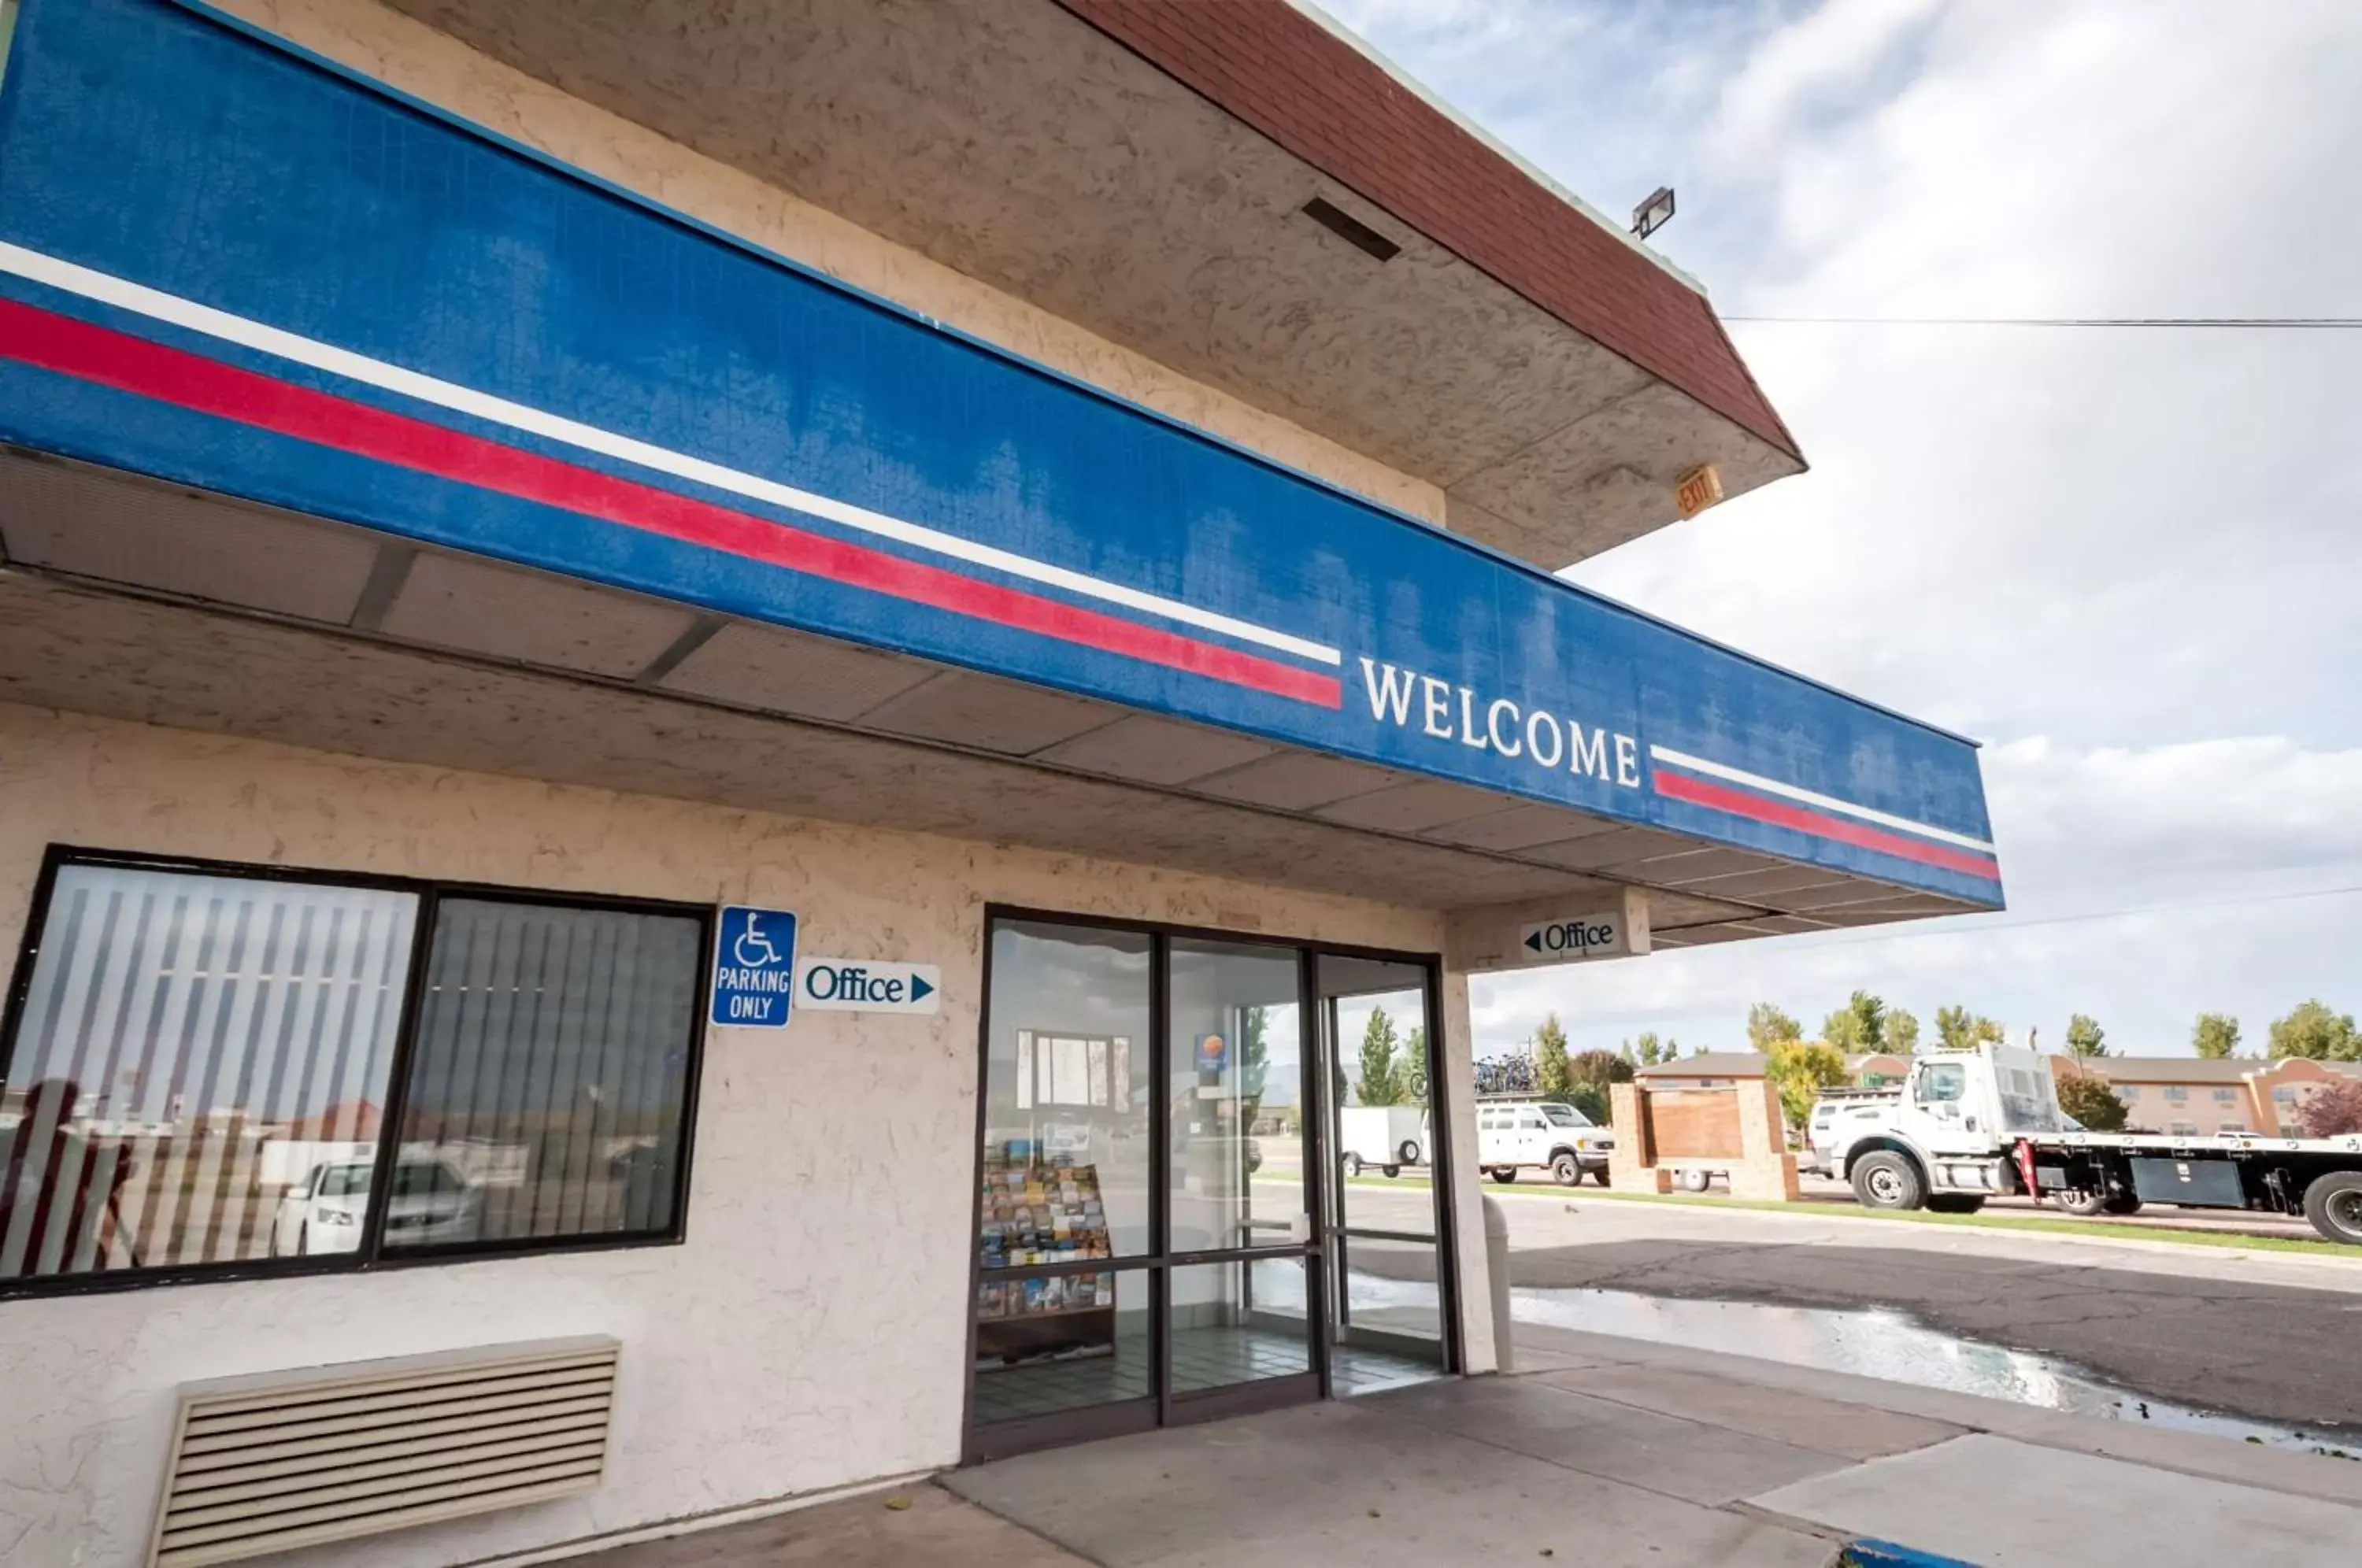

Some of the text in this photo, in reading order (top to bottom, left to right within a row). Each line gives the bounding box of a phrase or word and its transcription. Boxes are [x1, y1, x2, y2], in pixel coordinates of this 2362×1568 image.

[1679, 474, 1709, 512] EXIT
[1359, 656, 1640, 788] WELCOME
[1546, 922, 1612, 950] Office
[717, 967, 789, 993] PARKING
[805, 966, 903, 1003] Office
[730, 995, 773, 1019] ONLY
